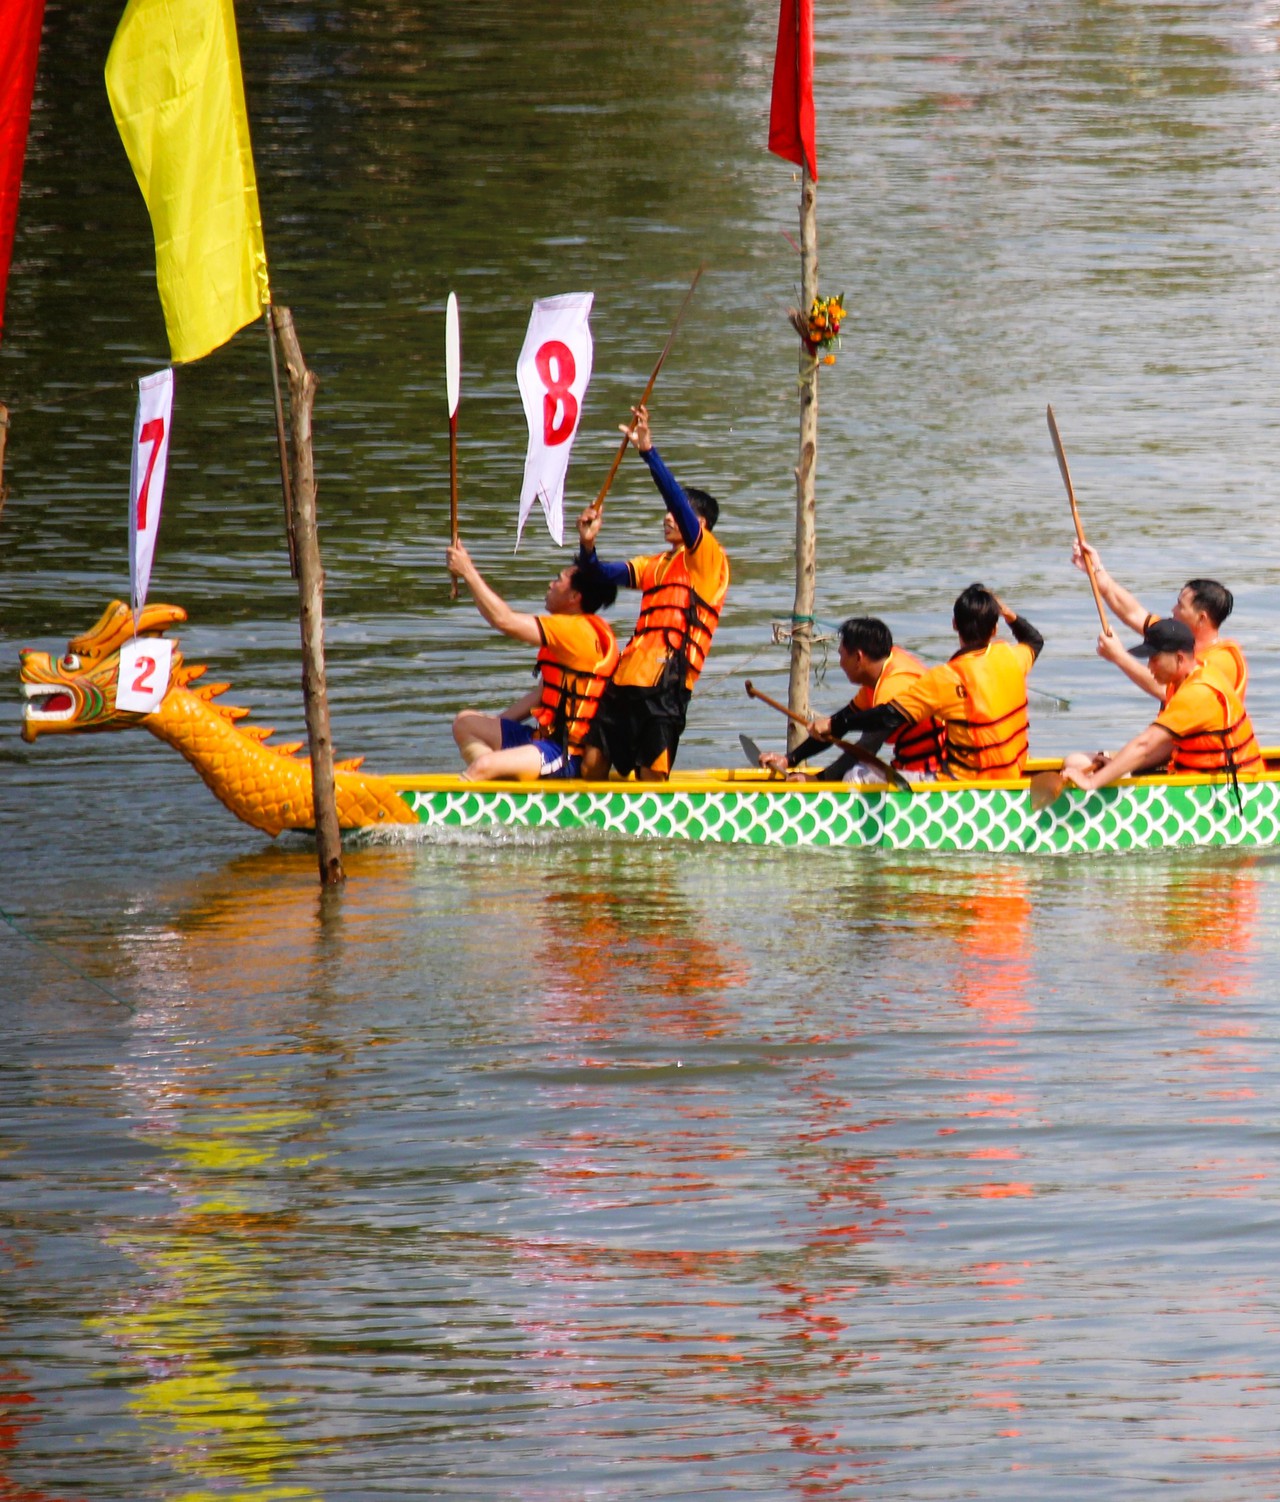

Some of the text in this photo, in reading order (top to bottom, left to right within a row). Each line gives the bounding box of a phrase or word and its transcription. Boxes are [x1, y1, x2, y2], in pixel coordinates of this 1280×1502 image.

[535, 340, 578, 446] 8
[137, 418, 164, 530] 7
[132, 657, 155, 693] 2
